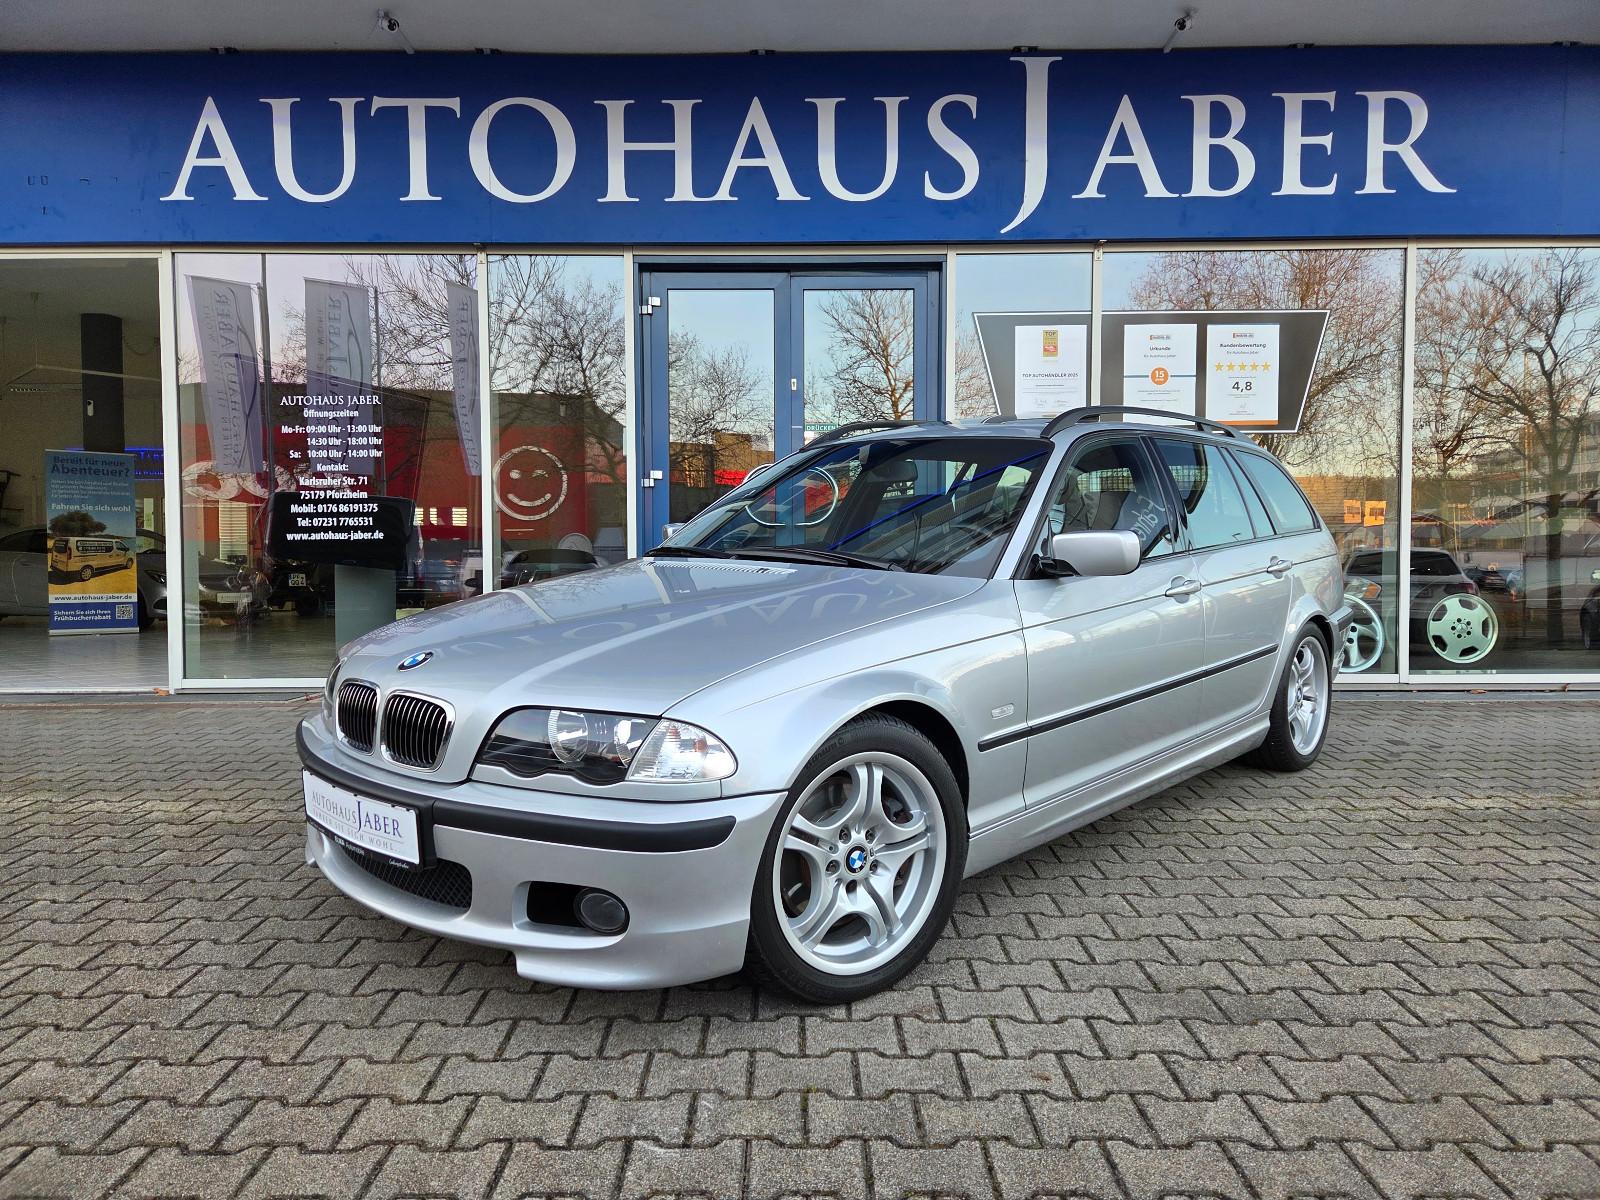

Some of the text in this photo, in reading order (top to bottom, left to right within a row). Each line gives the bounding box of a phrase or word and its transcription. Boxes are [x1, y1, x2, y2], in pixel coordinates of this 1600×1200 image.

[160, 56, 1458, 234] AUTOHAUS JABER
[1155, 370, 1165, 378] 15
[1232, 381, 1253, 393] 4,8
[280, 395, 382, 406] AUTOHAUS JABER
[303, 408, 359, 419] Öffnungszeiten
[281, 425, 306, 434] Mo-Fr:
[306, 425, 327, 433] 09:00
[328, 425, 342, 433] Uhr
[347, 424, 367, 433] 13:00
[368, 424, 382, 433] Uhr
[307, 438, 327, 446] 14:30
[328, 437, 342, 446] Uhr
[348, 437, 367, 445] 18:00
[369, 437, 382, 445] Uhr
[289, 450, 302, 459] Sa:
[307, 450, 327, 458] 10:00
[329, 450, 342, 458] Uhr
[348, 449, 368, 458] 14:00
[369, 449, 383, 458] Uhr
[53, 455, 83, 465] Bereit
[85, 457, 99, 466] für
[51, 464, 130, 477] Abenteuer?
[317, 463, 349, 472] Kontakt:
[299, 476, 368, 486] Karlsruher Str. 71
[300, 490, 368, 500] 75179 Pforzheim
[51, 502, 80, 511] Fahren
[81, 503, 94, 511] Sie
[94, 504, 110, 512] sich
[290, 503, 378, 513] Mobil: 0176 86191375
[296, 517, 373, 527] Tel: 07231 7765531
[286, 530, 384, 541] www.autohaus-jaber.de
[312, 791, 403, 838] AUTOHAUS JABER
